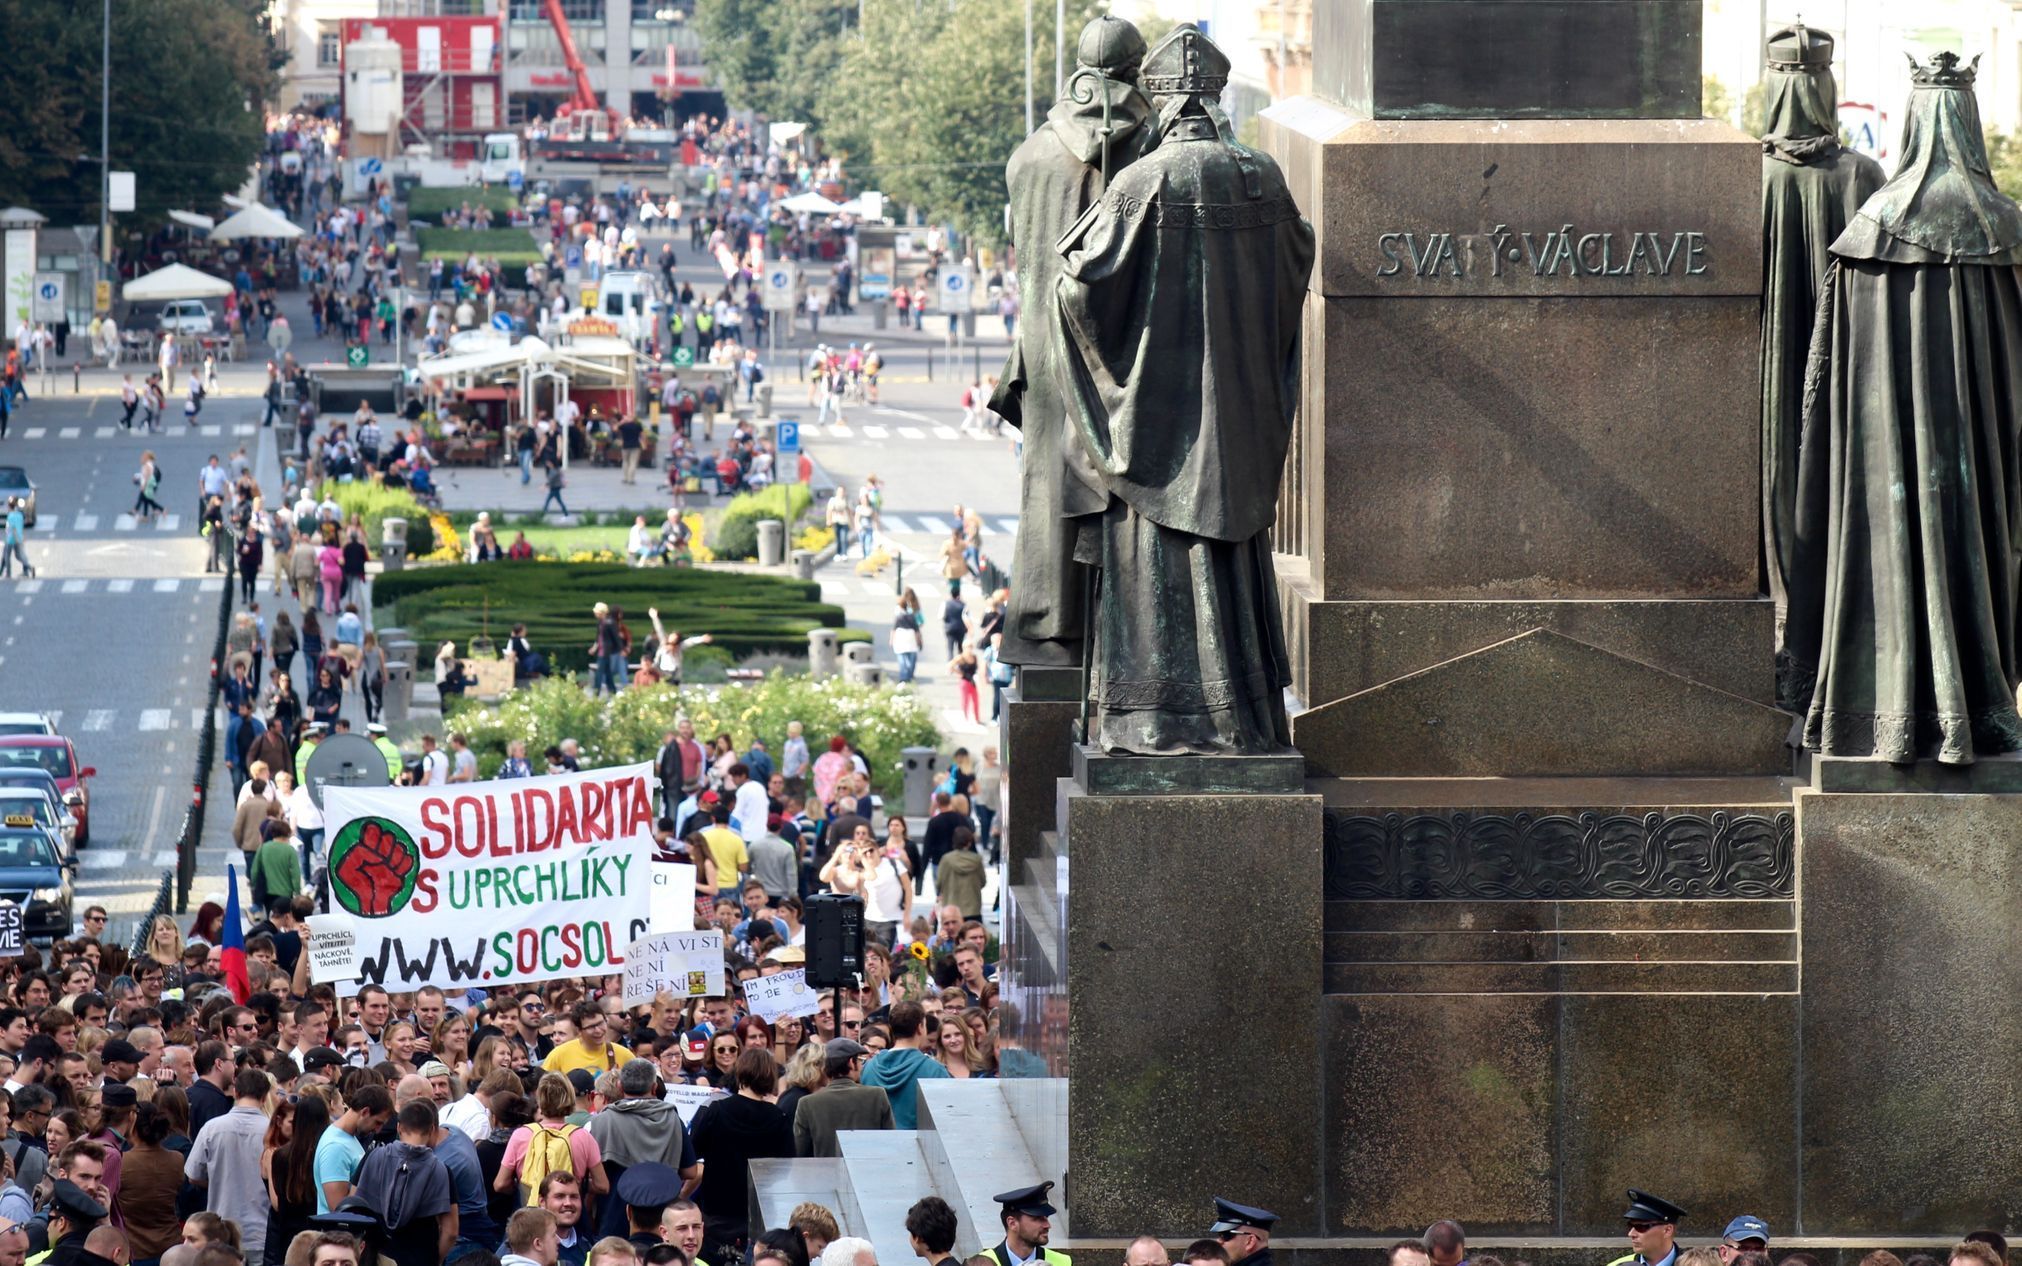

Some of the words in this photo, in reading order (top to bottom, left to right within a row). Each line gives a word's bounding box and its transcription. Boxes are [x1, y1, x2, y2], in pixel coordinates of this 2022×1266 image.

[781, 424, 795, 443] P
[420, 777, 653, 859] SOLIDARITA
[411, 868, 439, 914] S
[448, 846, 632, 910] UPRCHLÍKY
[766, 970, 804, 985] PROUD
[748, 993, 760, 1003] TO
[765, 987, 781, 998] BE
